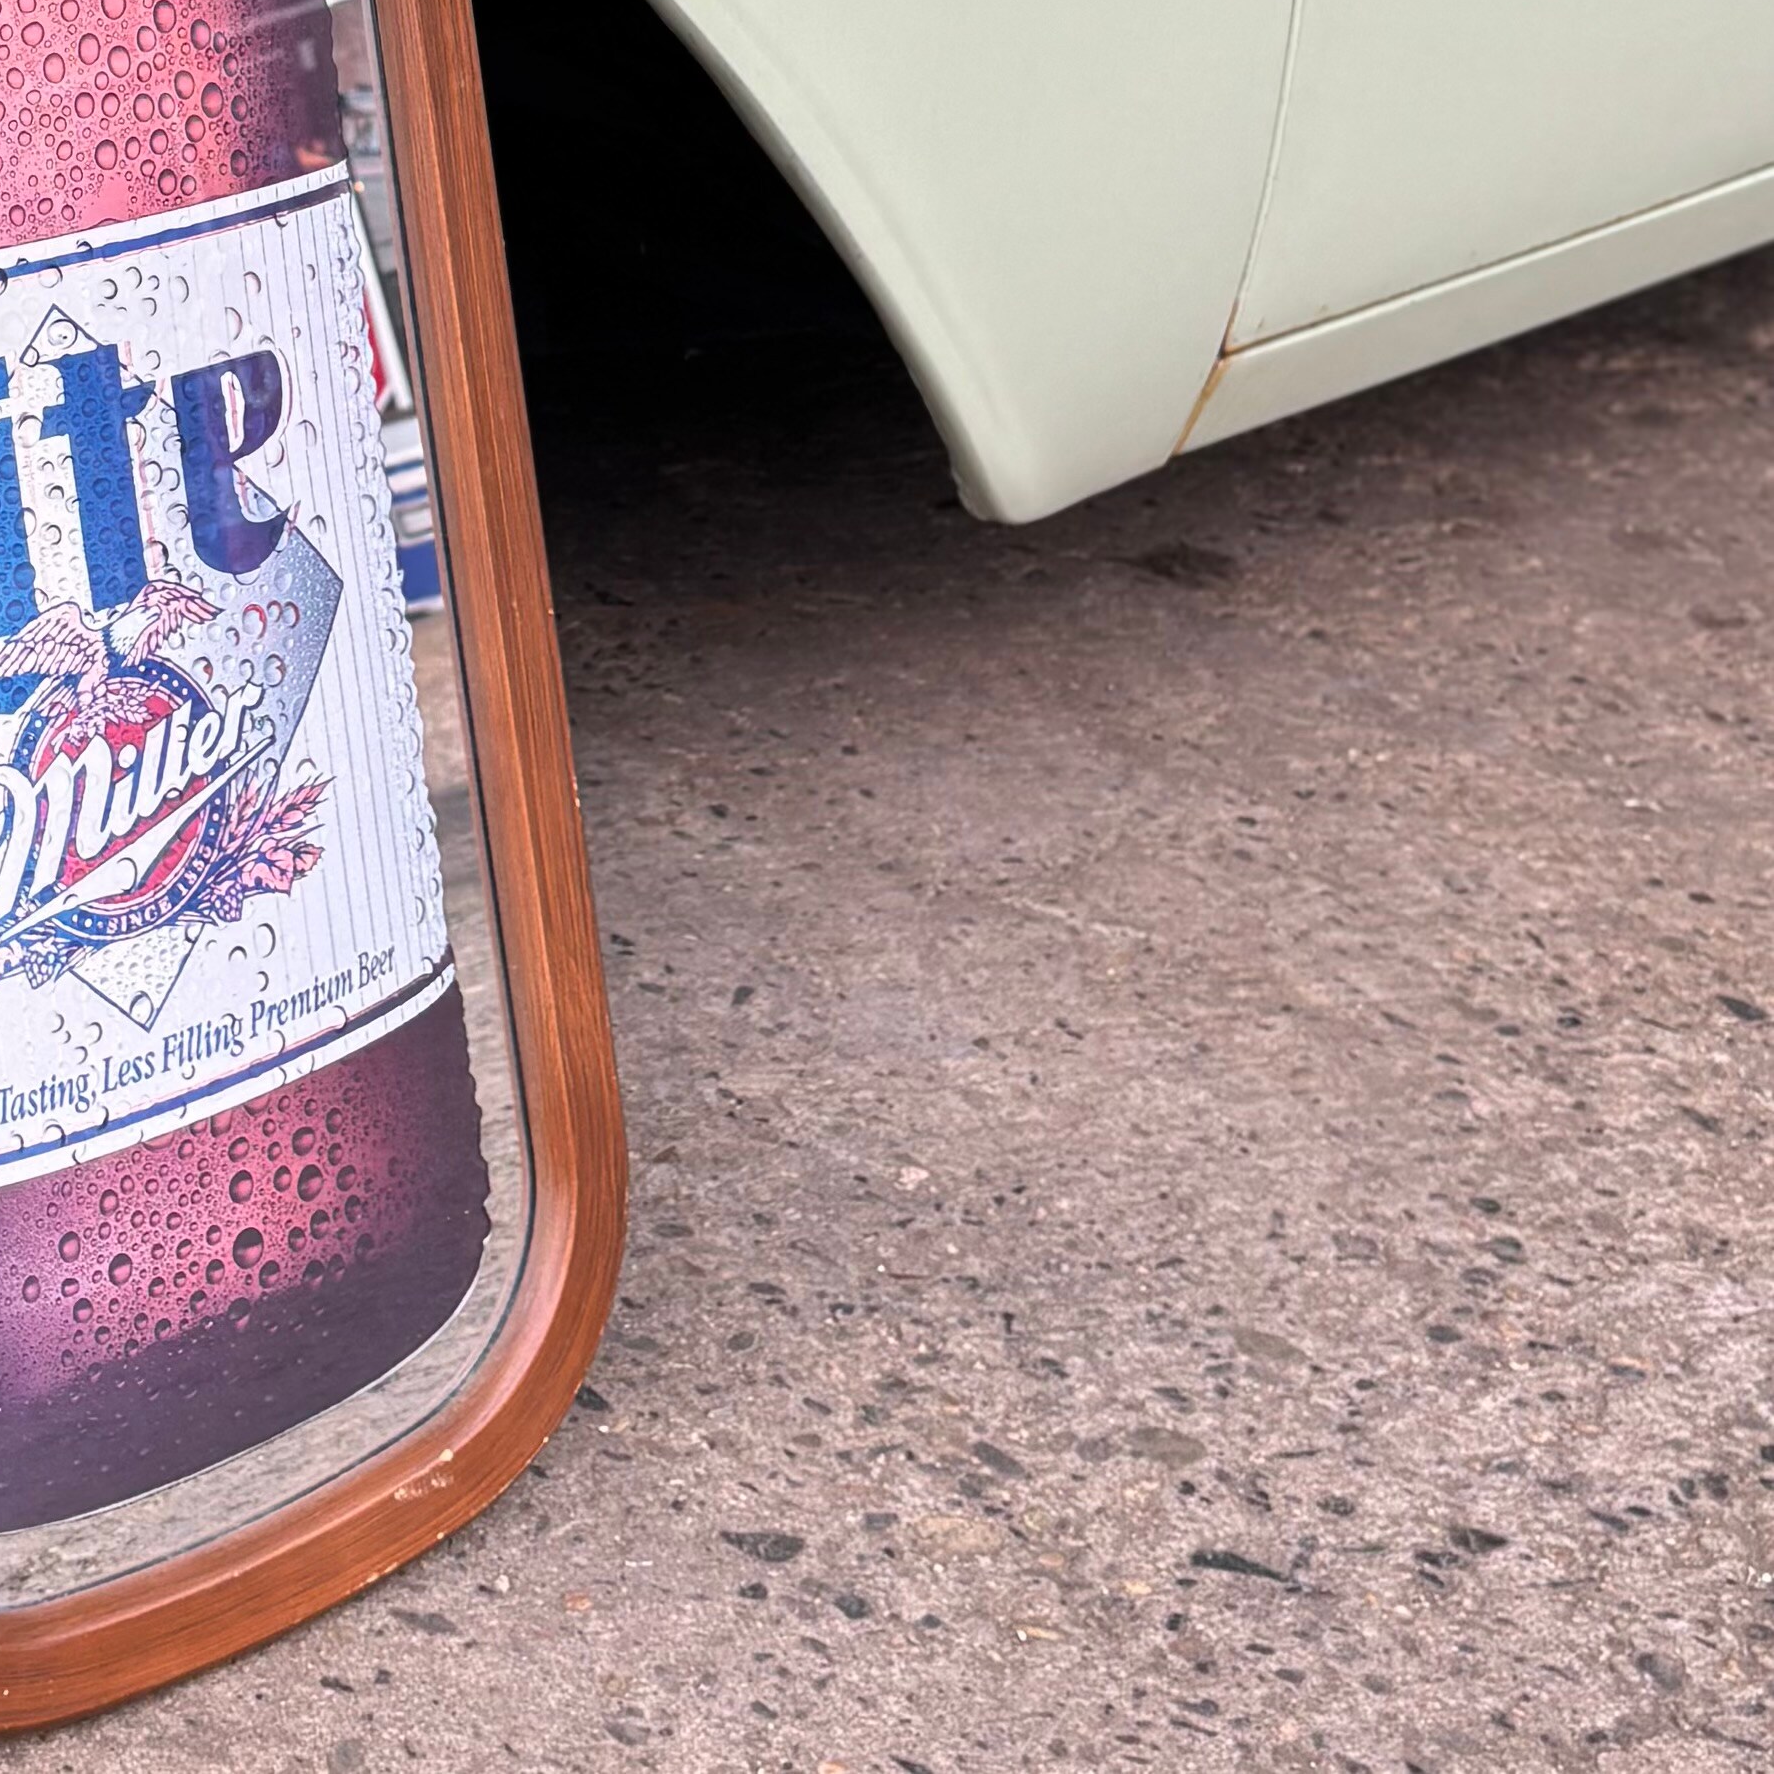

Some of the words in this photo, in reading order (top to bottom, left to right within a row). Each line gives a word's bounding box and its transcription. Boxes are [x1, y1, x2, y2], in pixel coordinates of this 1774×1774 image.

[106, 895, 173, 935] SINCE
[102, 1051, 156, 1094] Less
[161, 1017, 244, 1074] Filling
[249, 966, 354, 1039] Premium
[357, 945, 396, 990] Beer
